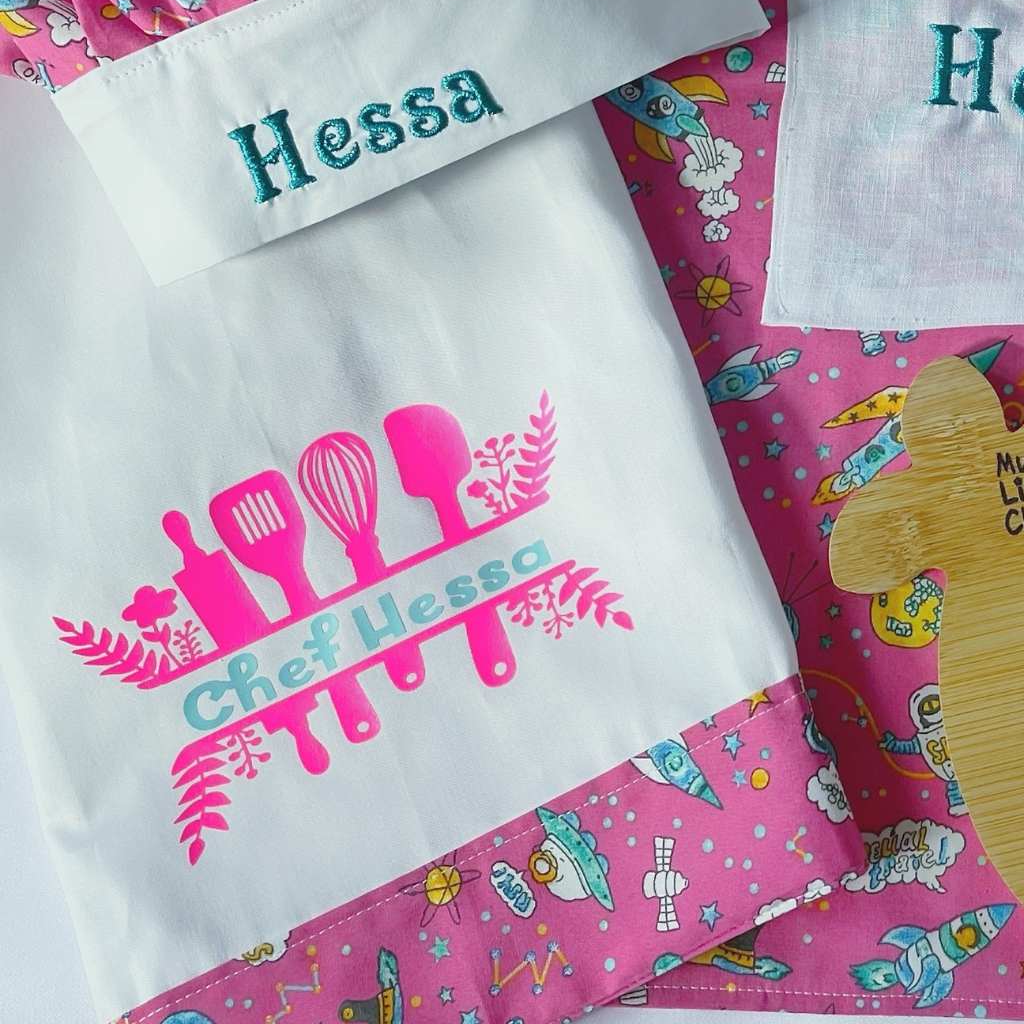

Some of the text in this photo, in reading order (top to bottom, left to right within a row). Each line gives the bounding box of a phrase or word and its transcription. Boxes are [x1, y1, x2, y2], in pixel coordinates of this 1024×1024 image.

[227, 69, 503, 204] Hessa
[183, 539, 553, 732] Chef Hessa
